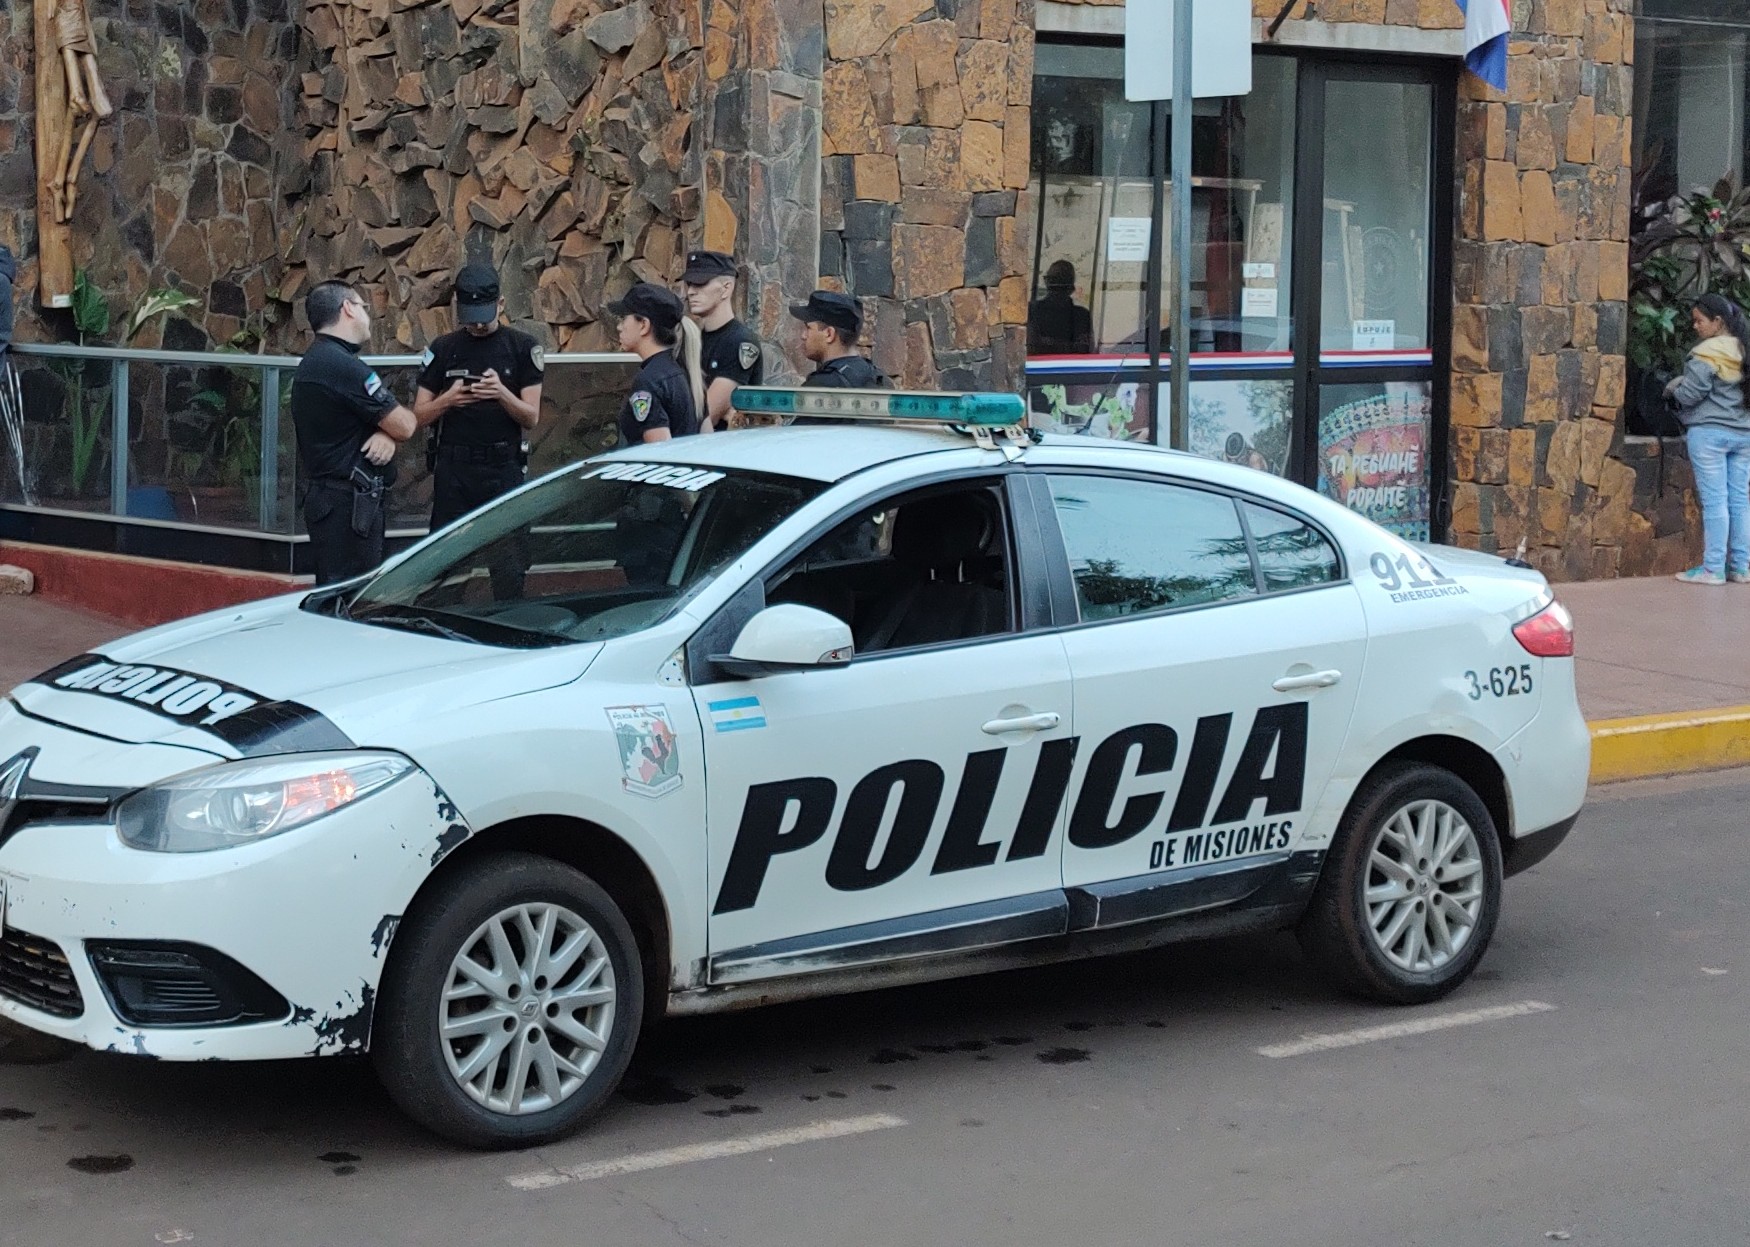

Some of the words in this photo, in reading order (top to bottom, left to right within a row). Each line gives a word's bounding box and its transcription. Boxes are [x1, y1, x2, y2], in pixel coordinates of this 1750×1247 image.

[580, 462, 727, 492] POLICIA
[1390, 585, 1470, 604] EMERGENCIA
[1464, 664, 1533, 701] 3-625
[712, 700, 1310, 916] POLICIA
[1149, 838, 1178, 870] DE
[1183, 820, 1293, 864] MISIONES
